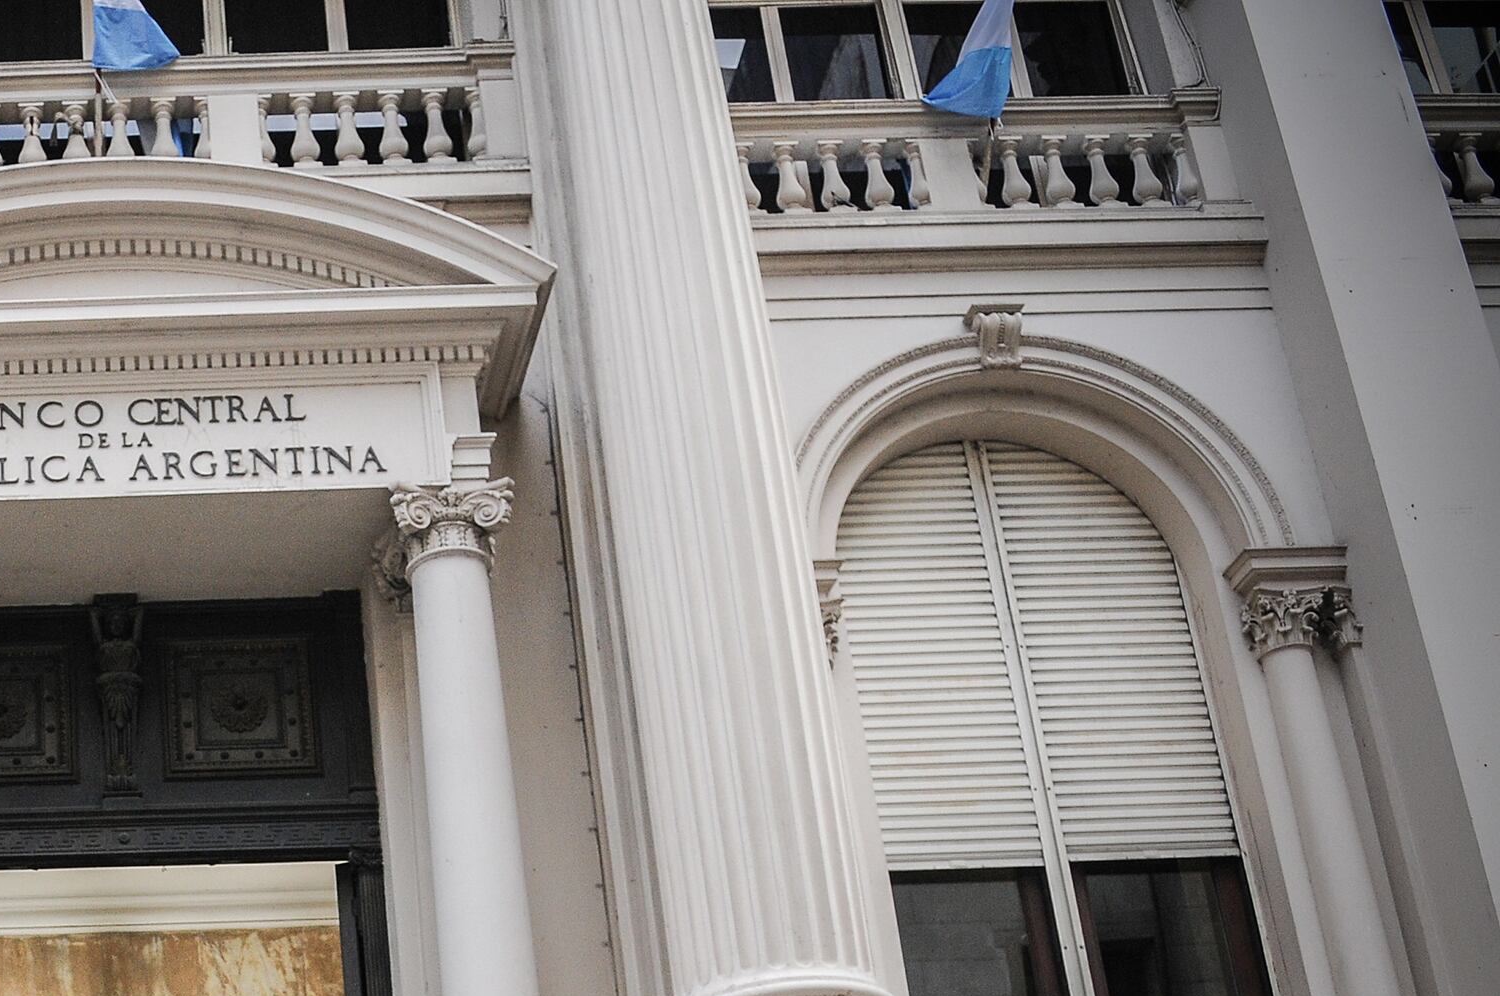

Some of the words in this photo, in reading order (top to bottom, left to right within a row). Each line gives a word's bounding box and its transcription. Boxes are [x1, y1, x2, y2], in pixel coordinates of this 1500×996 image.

[127, 394, 306, 428] CENTRAL
[77, 433, 110, 449] DE
[122, 432, 154, 448] LA
[128, 444, 388, 482] ARGENTINA
